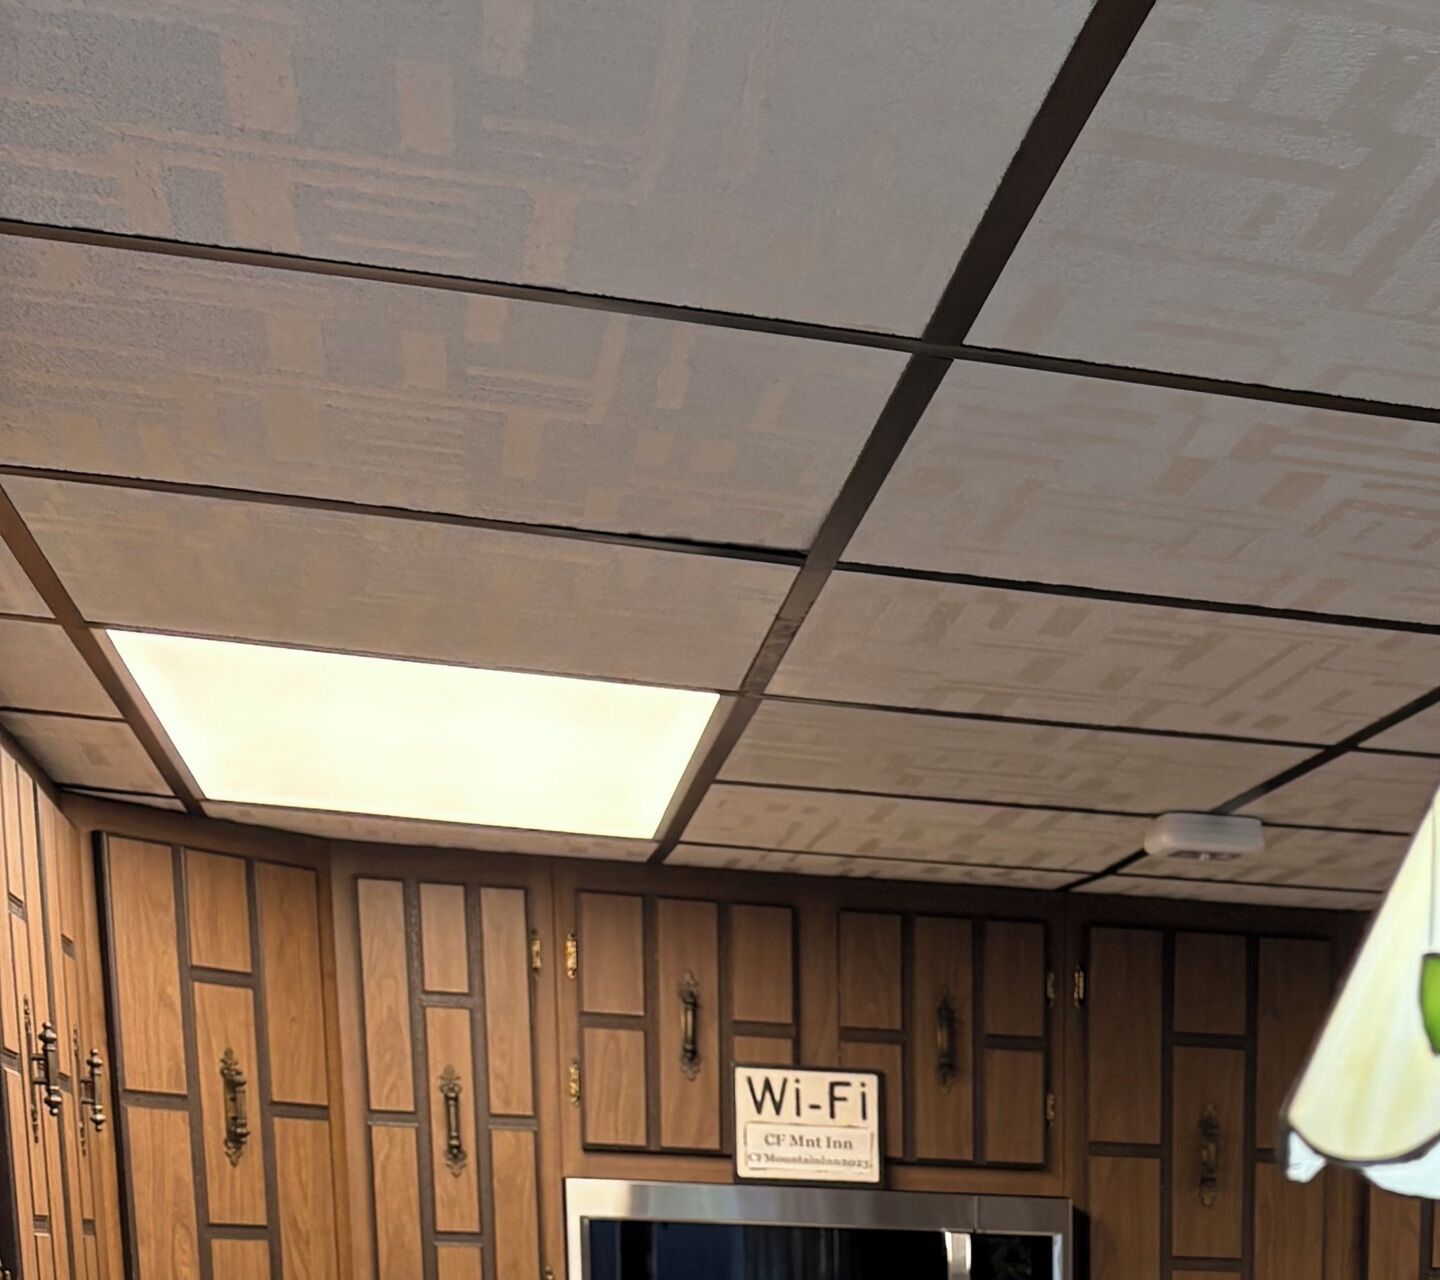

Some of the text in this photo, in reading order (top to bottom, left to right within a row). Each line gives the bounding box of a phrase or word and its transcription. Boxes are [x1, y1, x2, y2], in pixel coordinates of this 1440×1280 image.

[747, 1075, 868, 1121] Wi-Fi
[764, 1133, 853, 1150] CF Mnt Inn
